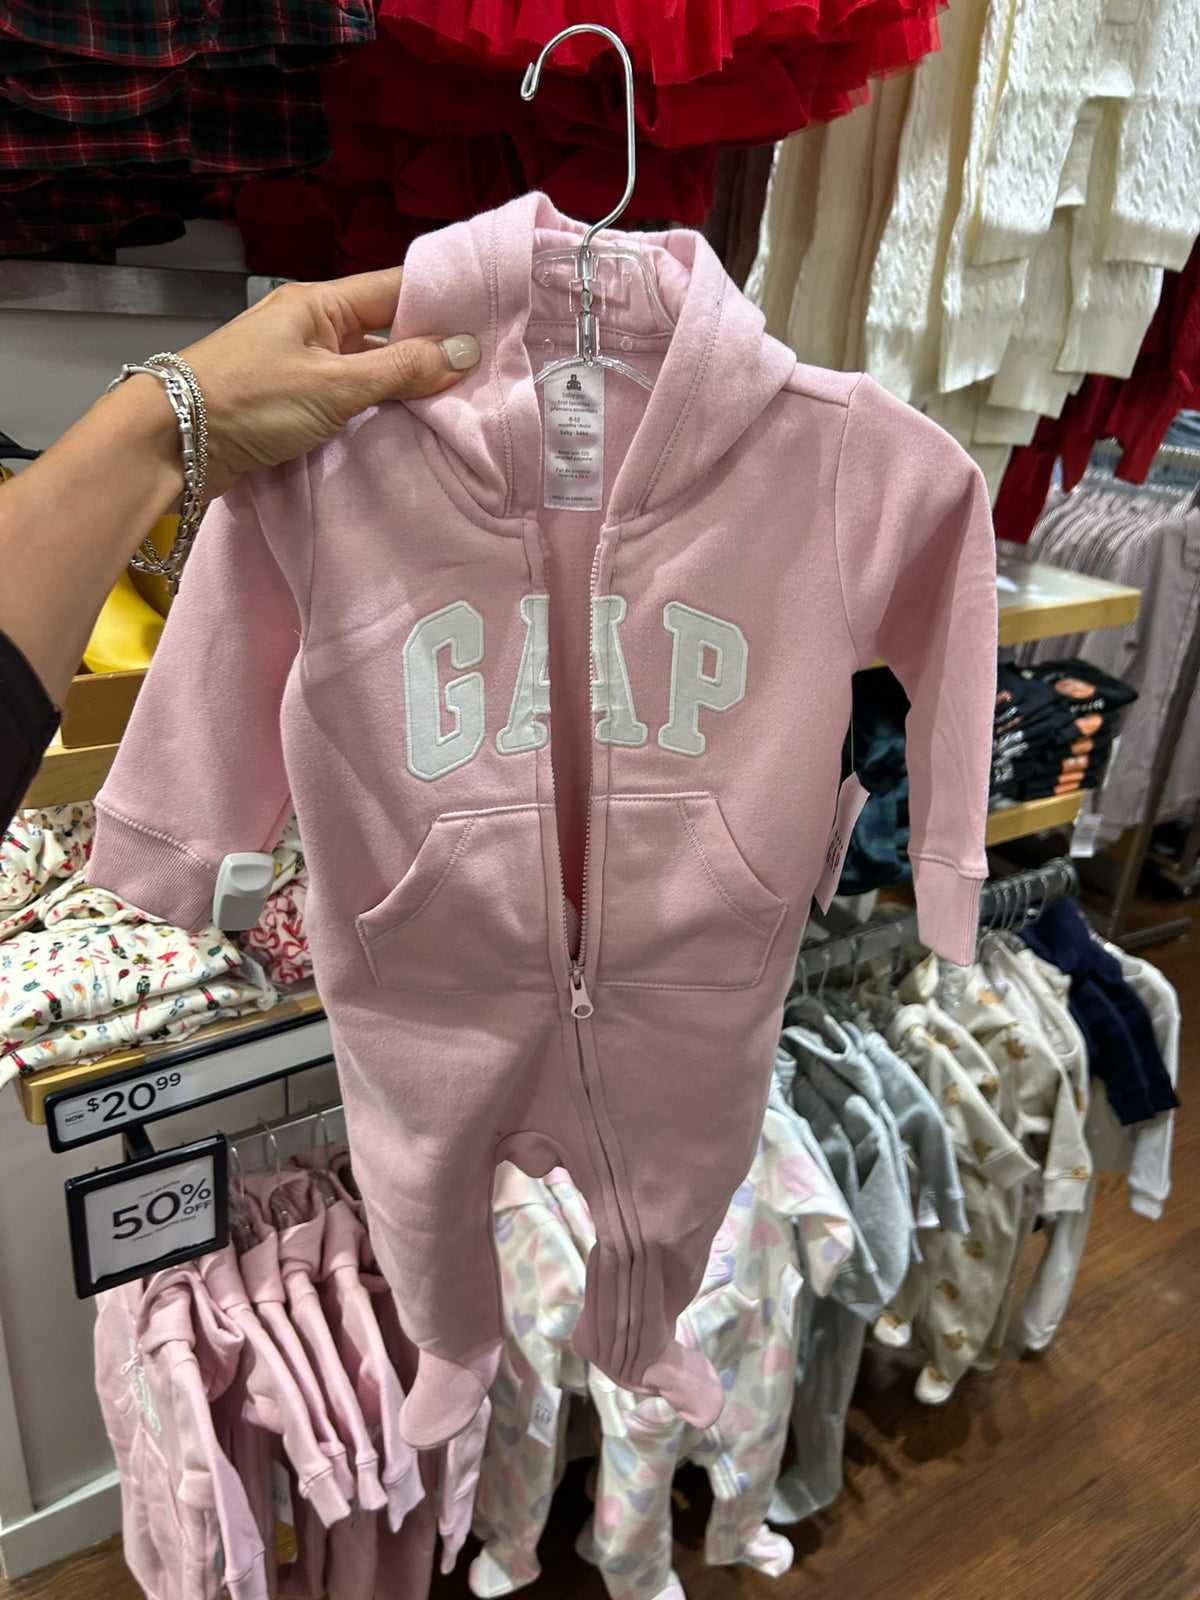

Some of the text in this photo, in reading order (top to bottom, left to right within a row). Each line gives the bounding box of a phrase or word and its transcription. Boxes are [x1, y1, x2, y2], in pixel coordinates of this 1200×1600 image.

[403, 594, 748, 782] GAP
[65, 1113, 84, 1123] NOW
[112, 1178, 211, 1240] 50%
[183, 1200, 212, 1215] OFF
